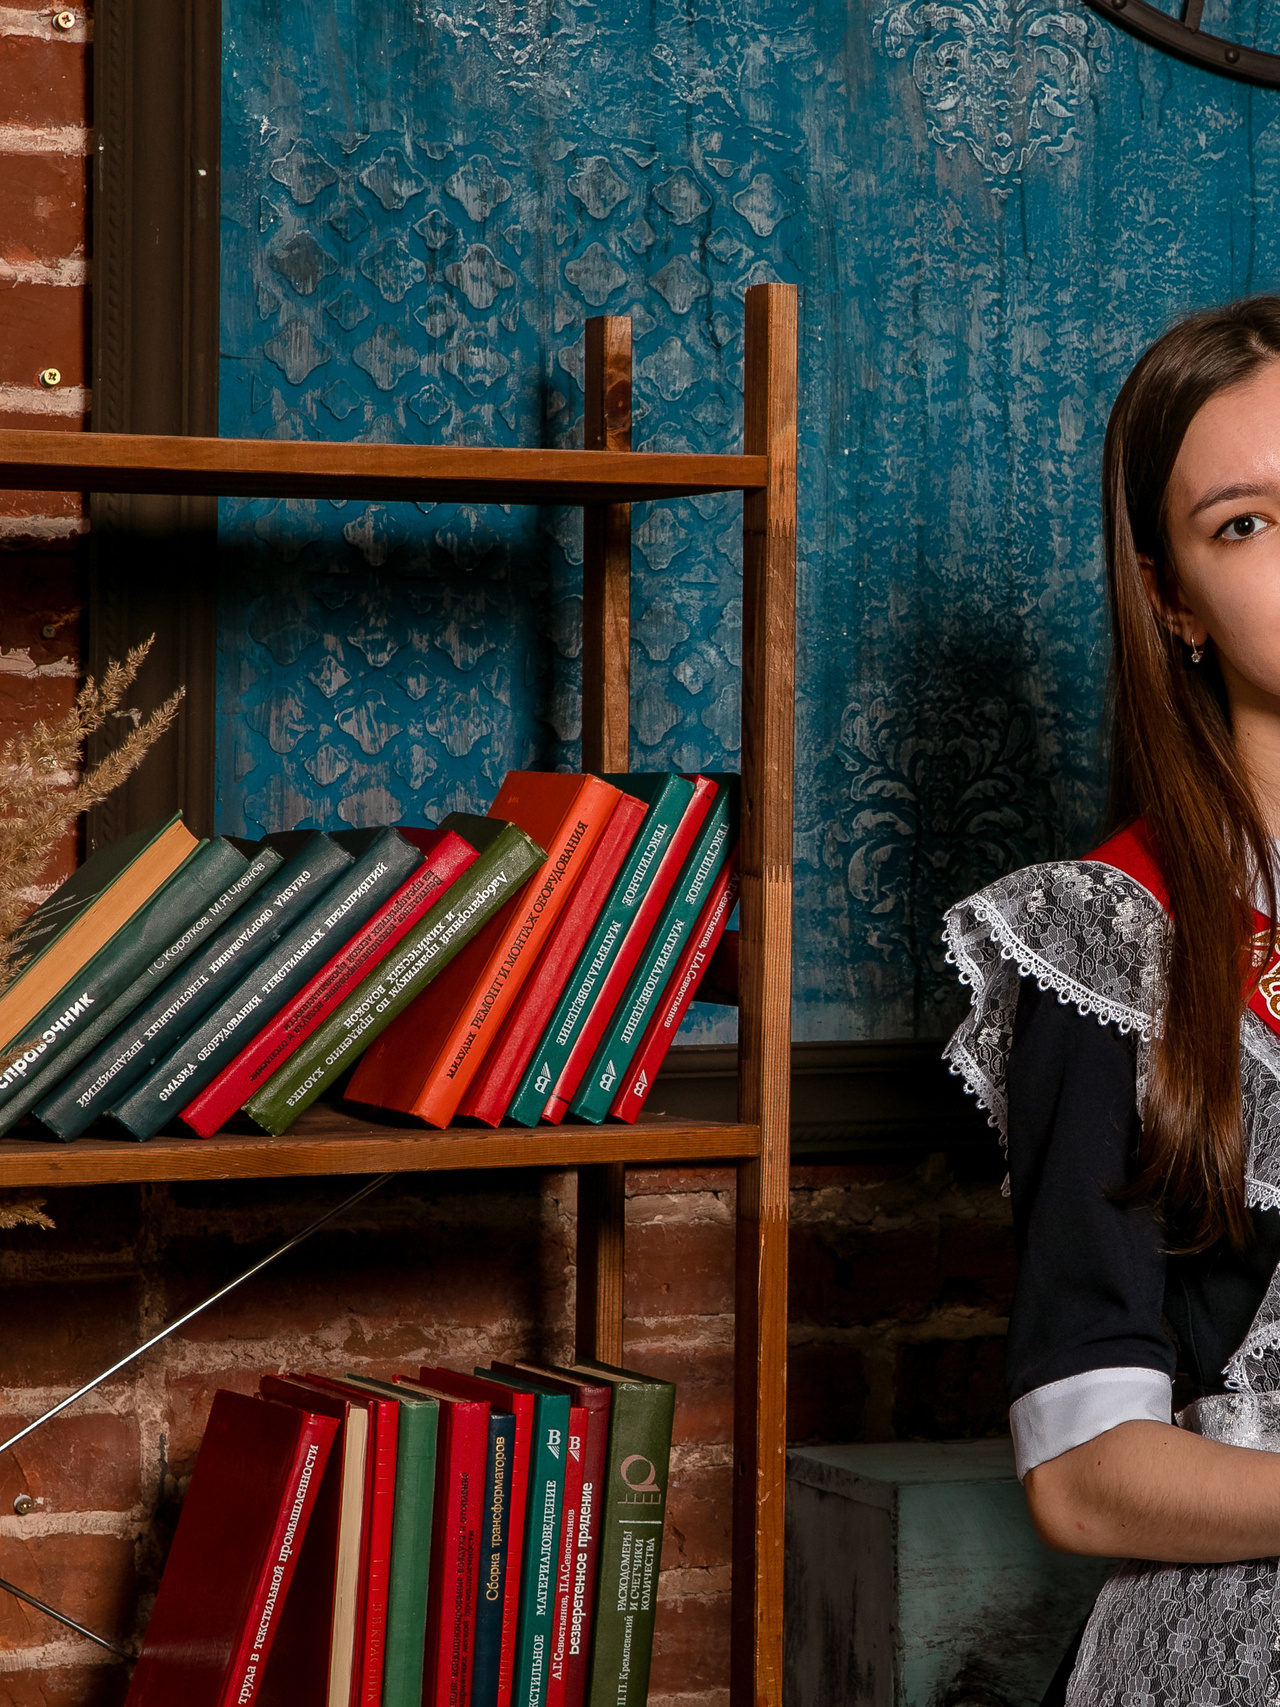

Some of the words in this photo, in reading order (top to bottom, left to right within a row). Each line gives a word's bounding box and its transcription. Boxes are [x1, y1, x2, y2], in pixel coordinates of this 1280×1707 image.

[272, 868, 313, 910] СМАЗКА
[531, 819, 590, 915] ОБОРУДОВАНИЯ
[620, 820, 668, 907] ТЕКСТИЛЬНОЕ
[683, 820, 731, 905] ТЕКСТИЛЬНОЕ
[370, 877, 425, 937] предприятиях
[436, 870, 510, 946] Лабораторный
[443, 910, 456, 923] и
[207, 906, 275, 974] ОБОРУДОВАНИЯ
[320, 921, 398, 1003] кондиционирование
[345, 934, 374, 965] легкой
[383, 920, 446, 985] химических
[386, 941, 442, 999] практикум
[503, 910, 540, 968] МОНТАЖ
[156, 1059, 198, 1102] СМАЗКА
[195, 993, 263, 1063] ОБОРУДОВАНИЯ
[260, 927, 325, 995] ТЕКСТИЛЬНЫХ
[322, 860, 388, 930] ПРЕДПРИЯТИЙ
[281, 959, 349, 1033] промышленности
[469, 976, 505, 1030] РЕМОНТ
[497, 966, 511, 979] И
[553, 918, 622, 1046] МАТЕРИАЛОВЕДЕНИЕ
[618, 917, 686, 1044] МАТЕРИАЛОВЕДЕНИЕ
[142, 972, 209, 1041] ТЕКСТИЛЬНЫХ
[292, 1000, 325, 1035] воздуха
[341, 983, 386, 1030] волокон
[373, 995, 391, 1014] по
[247, 1039, 289, 1083] отопление
[285, 1032, 295, 1042] и
[322, 1012, 375, 1067] прядению
[74, 1038, 145, 1110] ПРЕДПРИЯТИЙ
[284, 1065, 325, 1108] хлопка
[277, 1442, 319, 1563] промышленности
[490, 1435, 505, 1548] трансформаторов
[577, 1481, 594, 1548] прядение
[456, 1534, 467, 1573] воздуха
[485, 1551, 501, 1601] Сборка
[536, 1479, 557, 1616] МАТЕРИАЛОВЕДЕНИЕ
[617, 1529, 633, 1611] РАСХОДОМЕРЫ
[629, 1537, 644, 1600] СЧЕТЧИКИ
[640, 1536, 655, 1610] КОЛИЧЕСТВА
[252, 1564, 285, 1651] текстильной
[629, 1602, 639, 1611] И
[237, 1663, 258, 1706] труда
[249, 1652, 260, 1662] в
